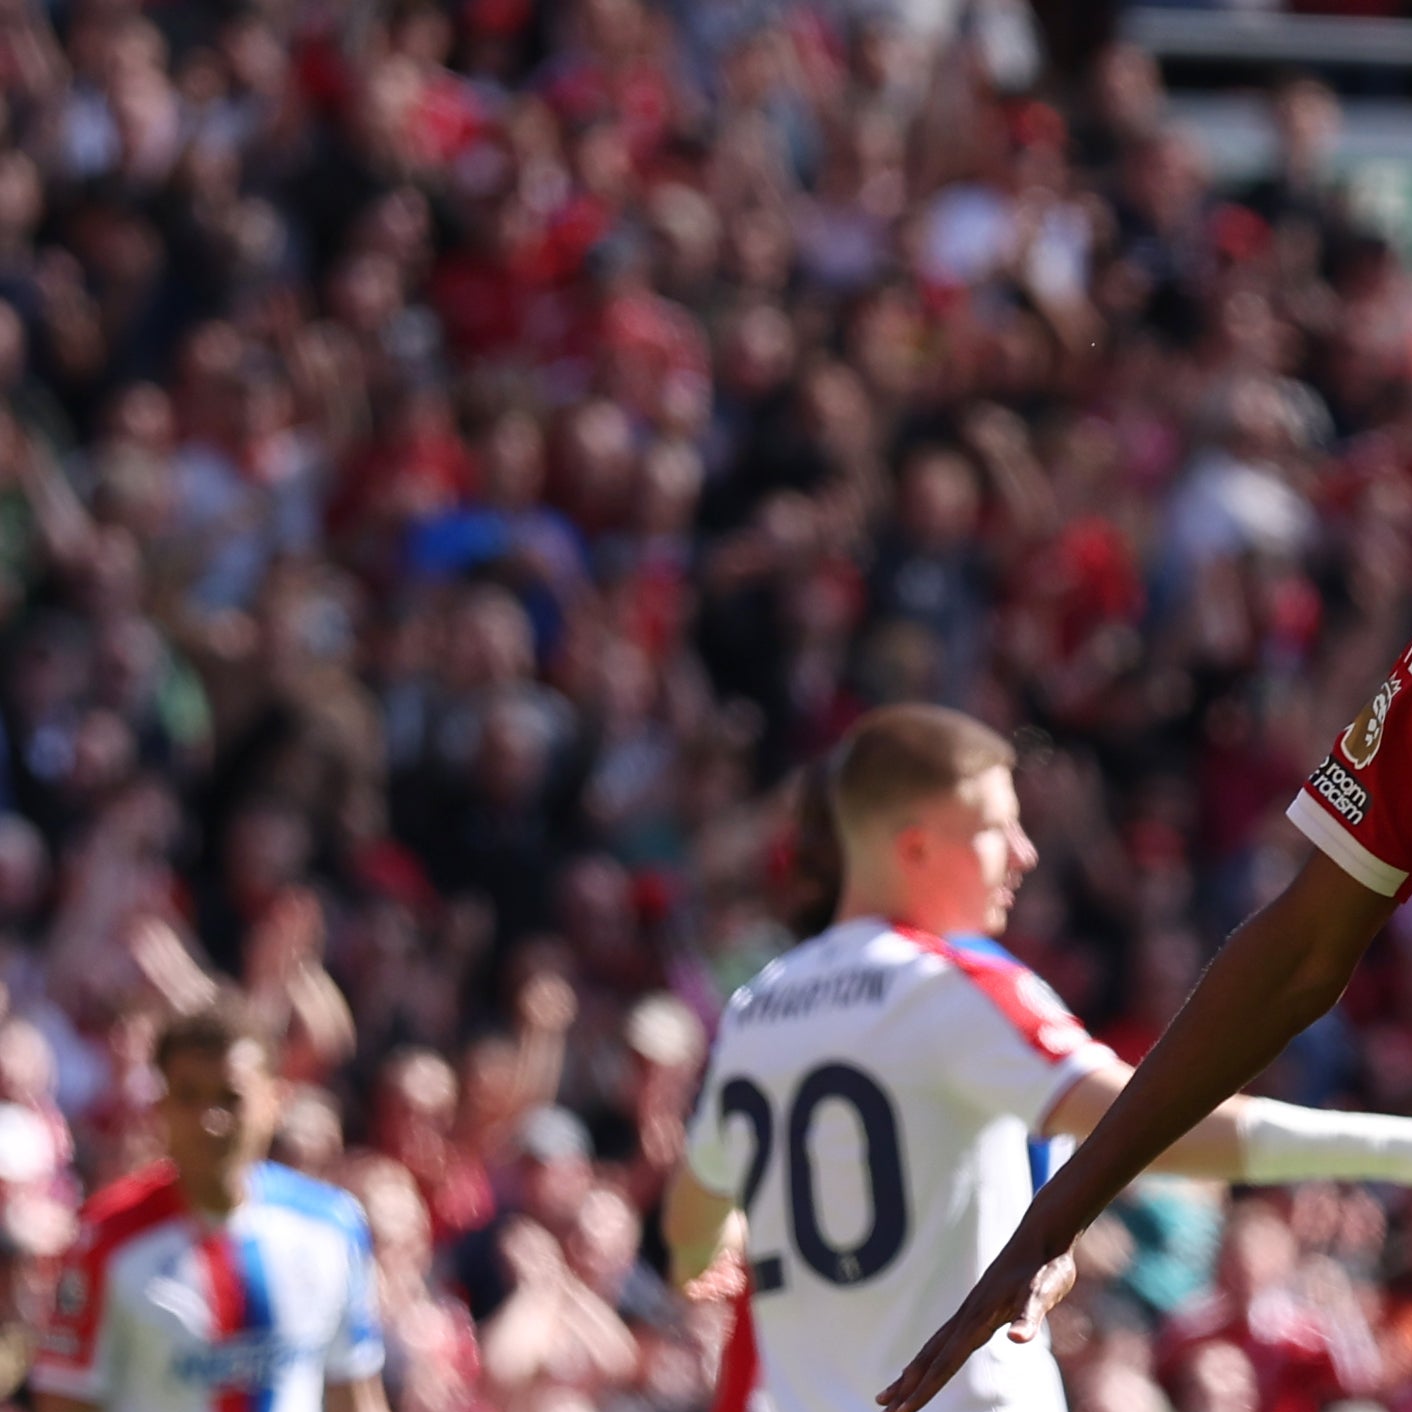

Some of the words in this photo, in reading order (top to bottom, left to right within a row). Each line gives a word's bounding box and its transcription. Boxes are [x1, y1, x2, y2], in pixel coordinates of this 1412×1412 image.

[1313, 773, 1363, 826] racism
[1326, 761, 1367, 807] room
[720, 1059, 909, 1290] 20
